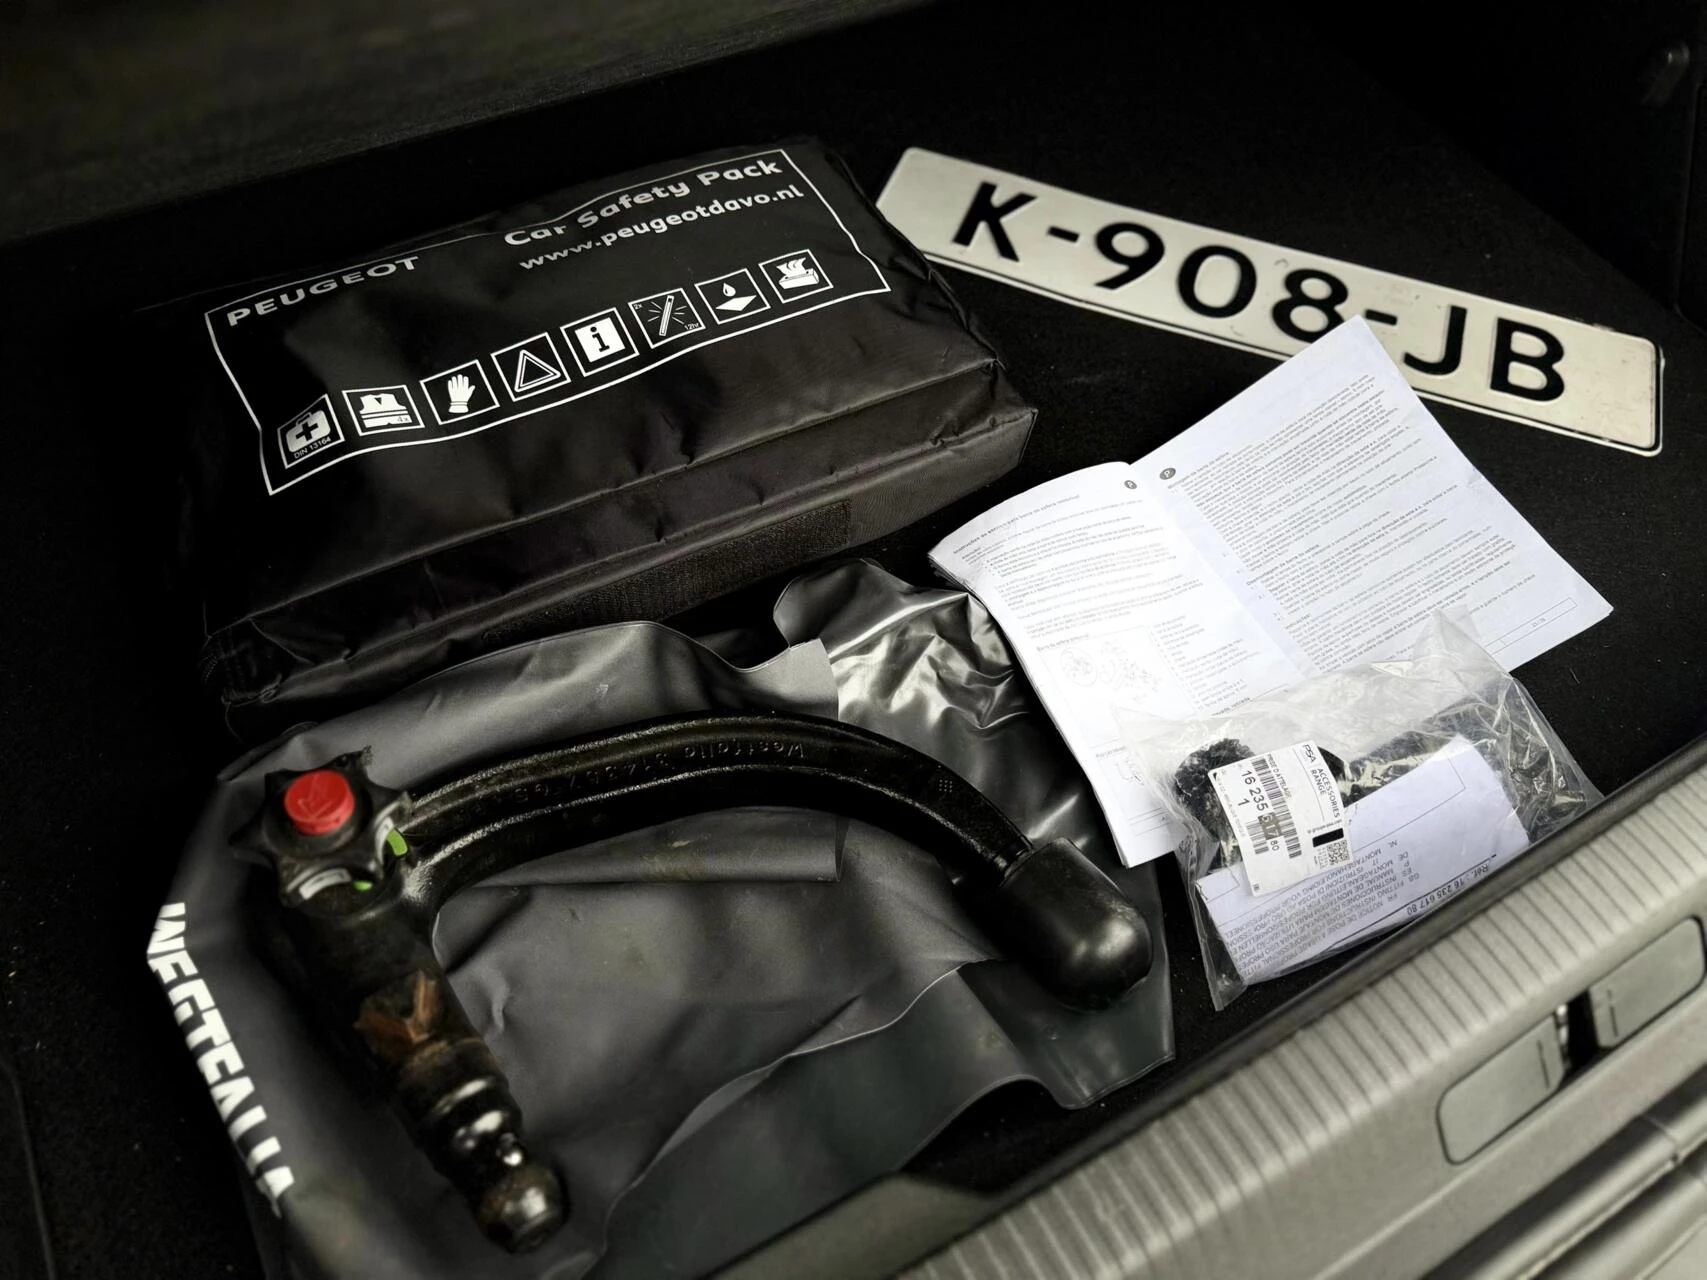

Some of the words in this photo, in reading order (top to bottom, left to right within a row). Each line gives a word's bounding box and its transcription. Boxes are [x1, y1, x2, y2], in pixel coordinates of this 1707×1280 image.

[504, 225, 567, 246] Car
[577, 181, 691, 228] Safety
[697, 159, 783, 186] Pack
[519, 184, 805, 270] www.peugeotdavo.nl
[226, 255, 420, 327] PEUGEOT
[951, 181, 1568, 403] K-908-JB
[293, 447, 308, 459] DIN
[309, 435, 332, 451] 13164
[1301, 742, 1317, 763] PSA
[1240, 769, 1256, 786] 16
[1309, 768, 1327, 795] RANGE
[1237, 797, 1249, 807] 1
[1248, 785, 1268, 812] 235
[1316, 768, 1340, 817] ACCESSORIES
[1260, 813, 1279, 839] 617
[1269, 839, 1280, 851] 80
[1435, 884, 1454, 899] 235
[1405, 903, 1419, 916] 80
